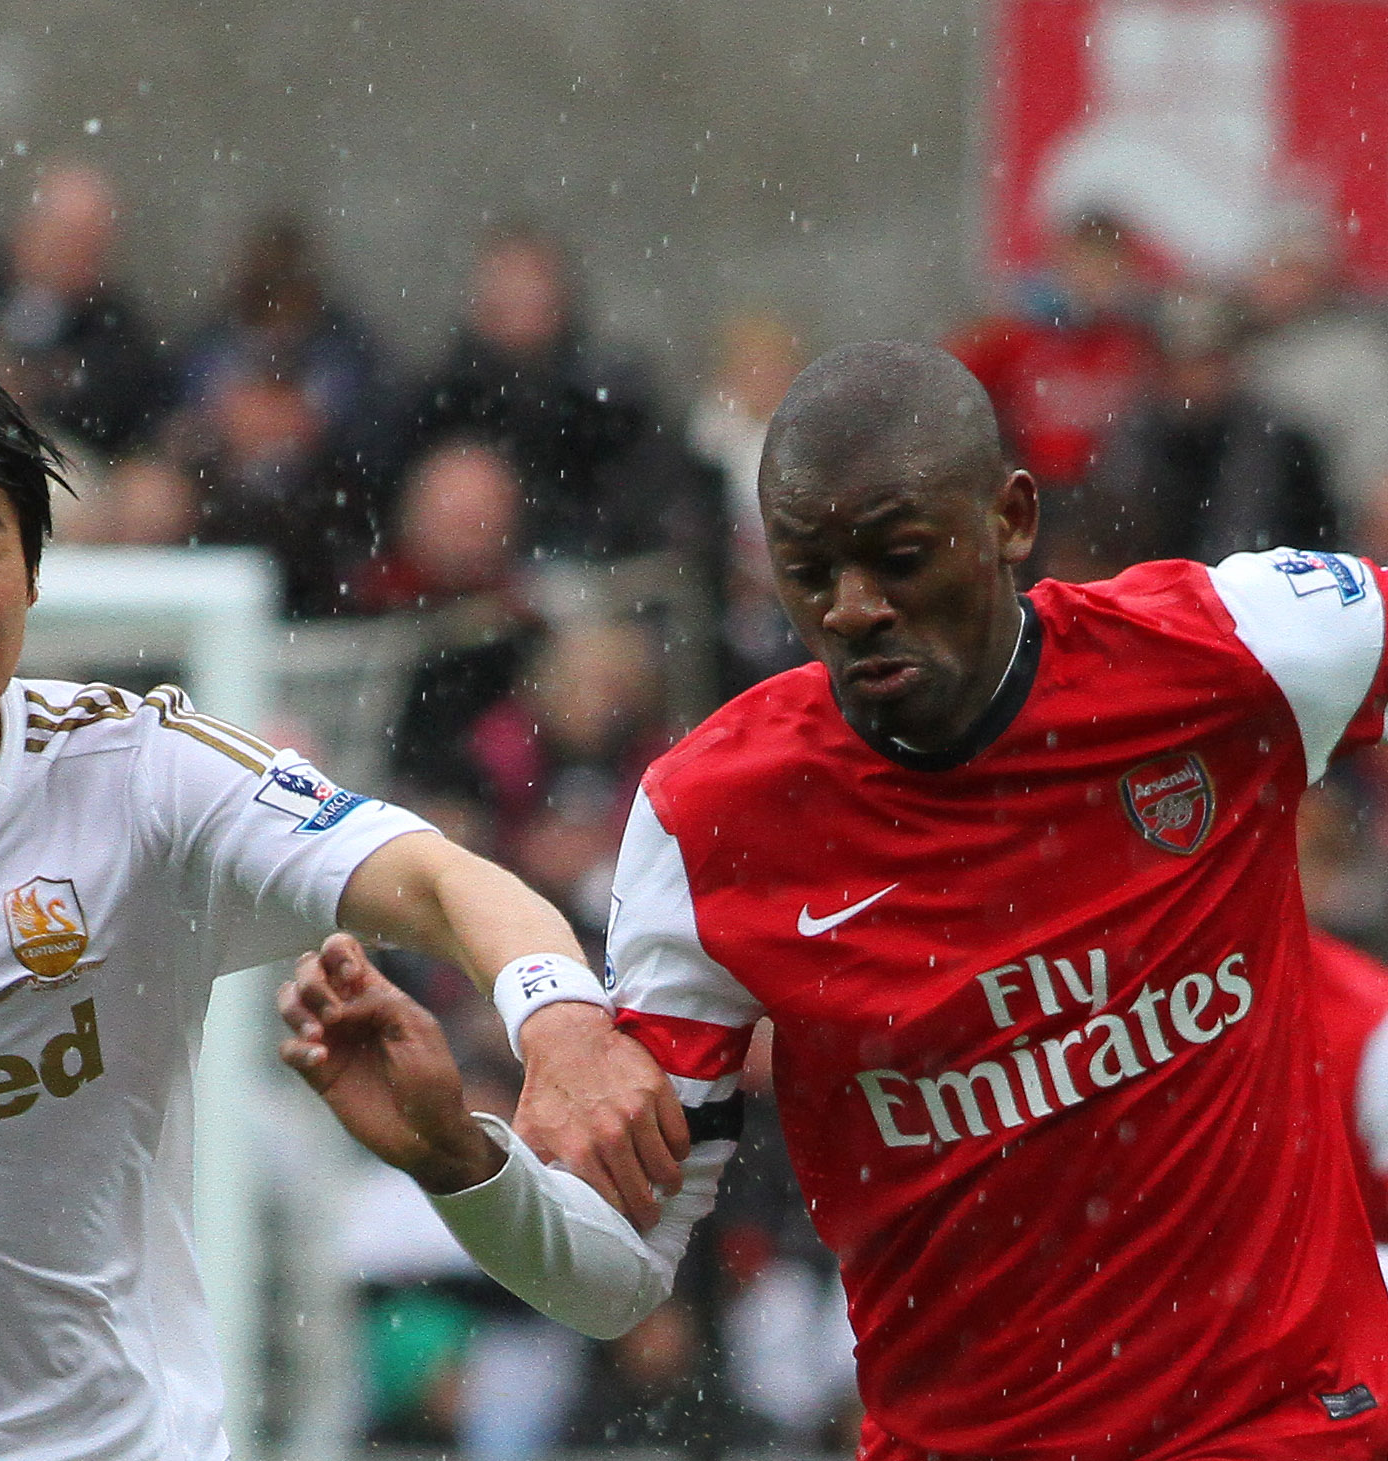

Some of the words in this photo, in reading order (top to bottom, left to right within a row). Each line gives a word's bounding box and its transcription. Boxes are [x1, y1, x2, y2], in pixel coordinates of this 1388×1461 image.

[1134, 764, 1200, 800] Arsenal
[523, 978, 559, 1000] KI
[975, 947, 1110, 1029] Fly
[855, 952, 1254, 1148] Emirates
